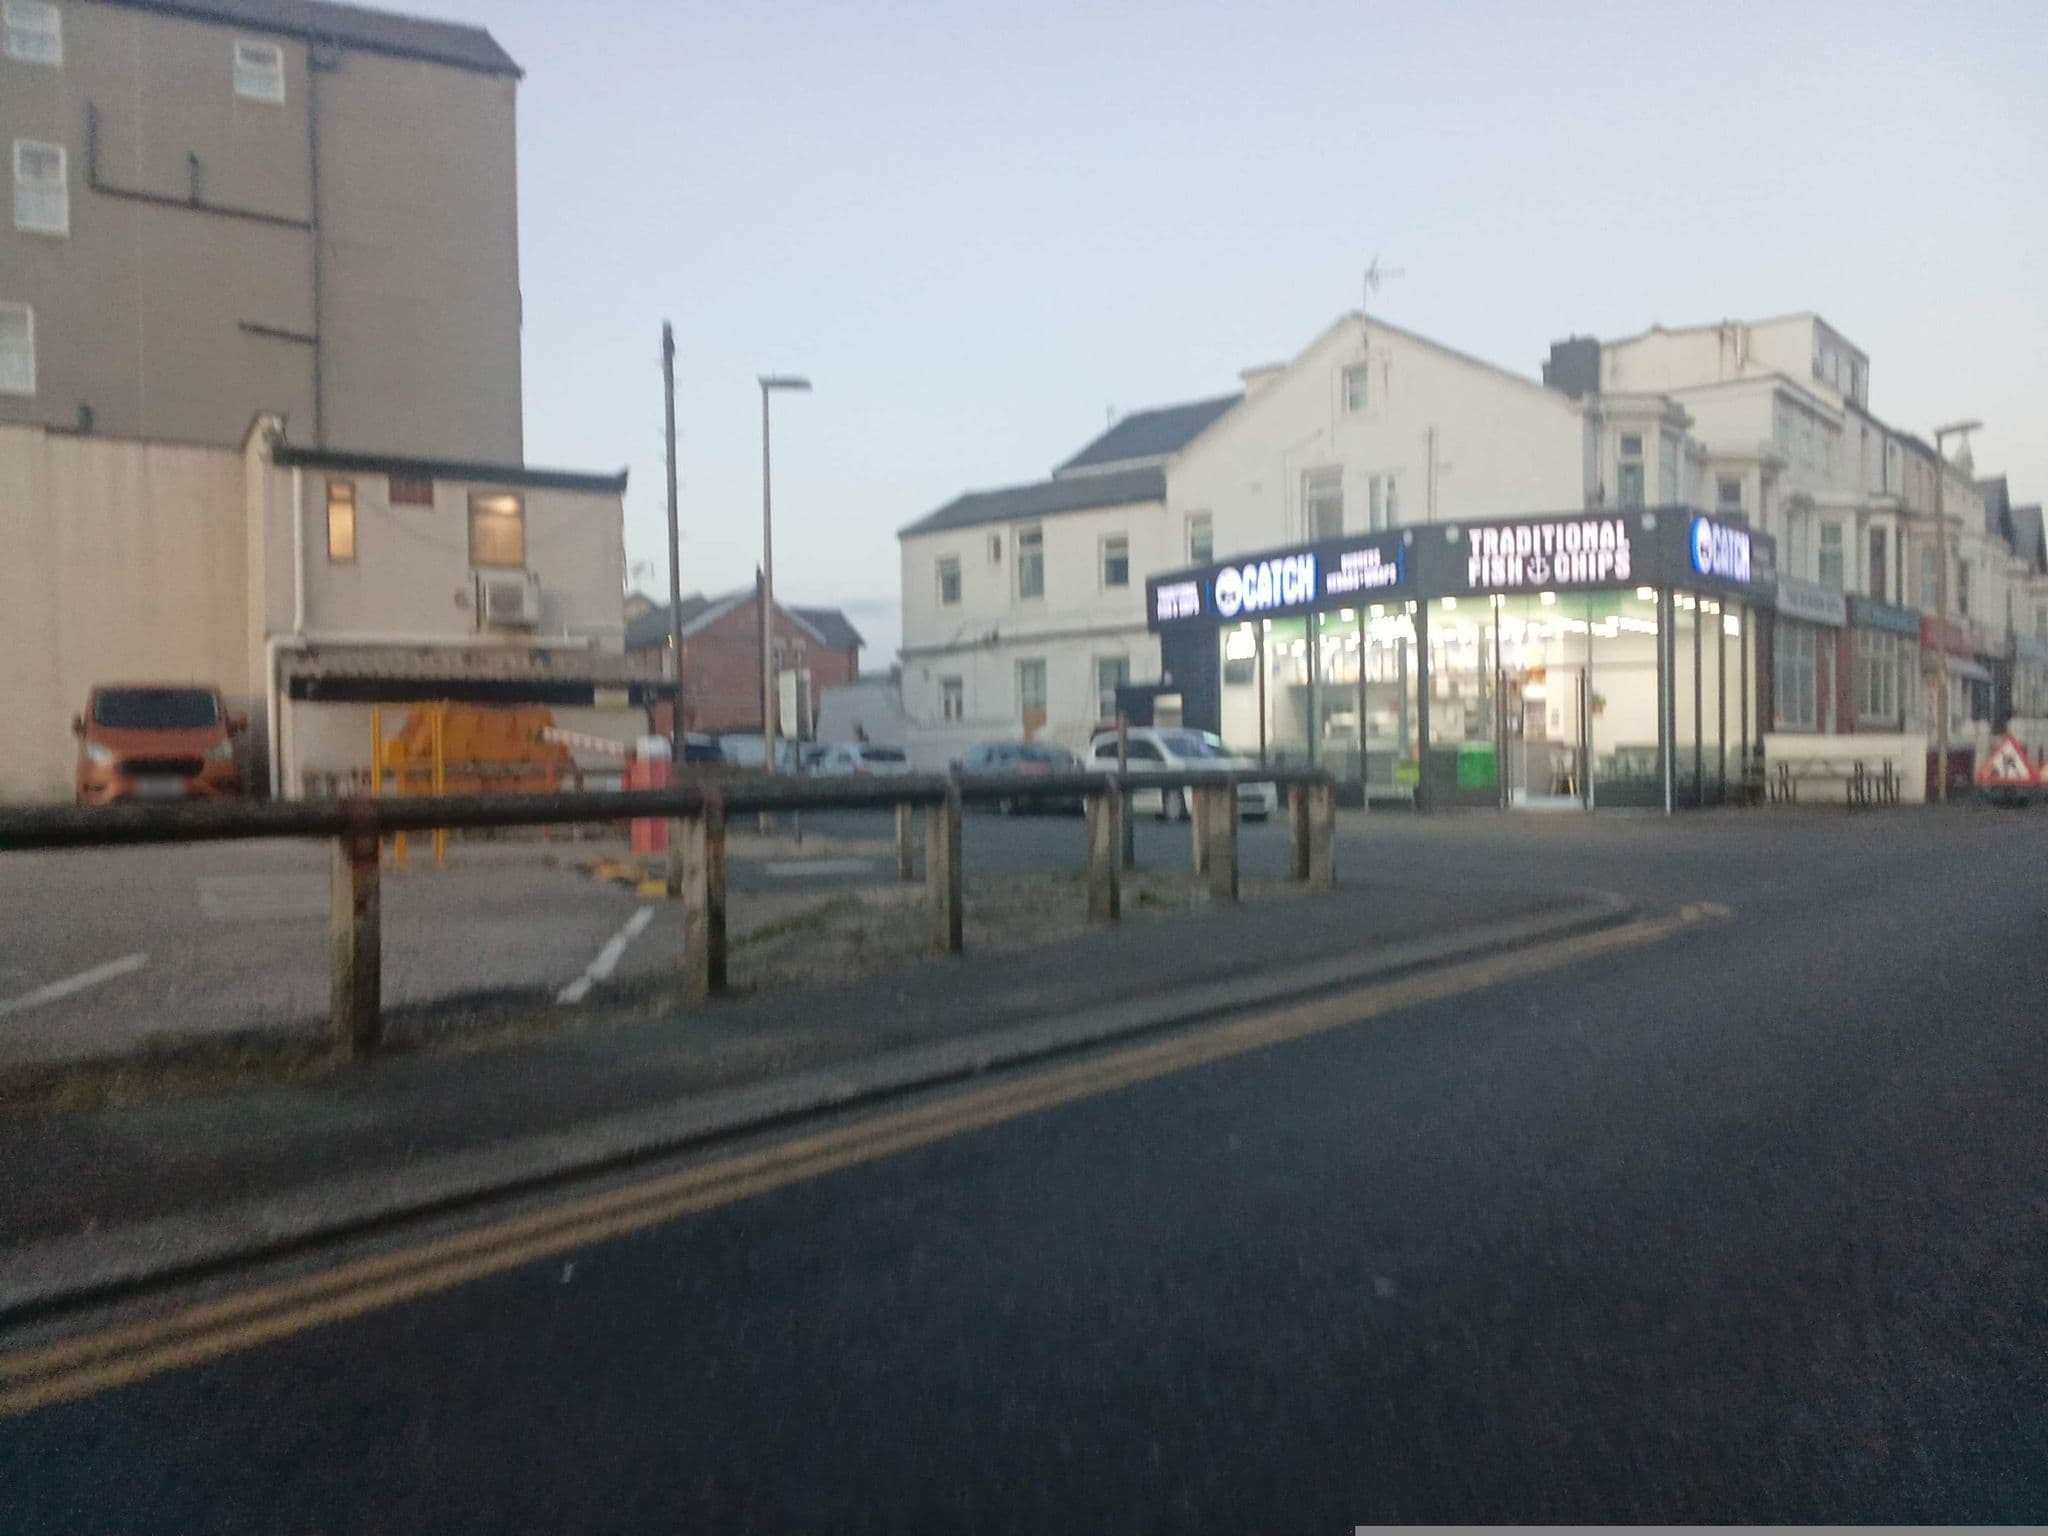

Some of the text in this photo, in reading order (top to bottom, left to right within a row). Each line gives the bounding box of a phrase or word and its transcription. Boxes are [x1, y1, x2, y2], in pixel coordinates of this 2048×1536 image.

[1469, 519, 1626, 556] TRADITIONAL
[1713, 523, 1751, 582] CATCH
[1243, 552, 1316, 610] CATCH
[1468, 542, 1631, 587] FISH CHIPS
